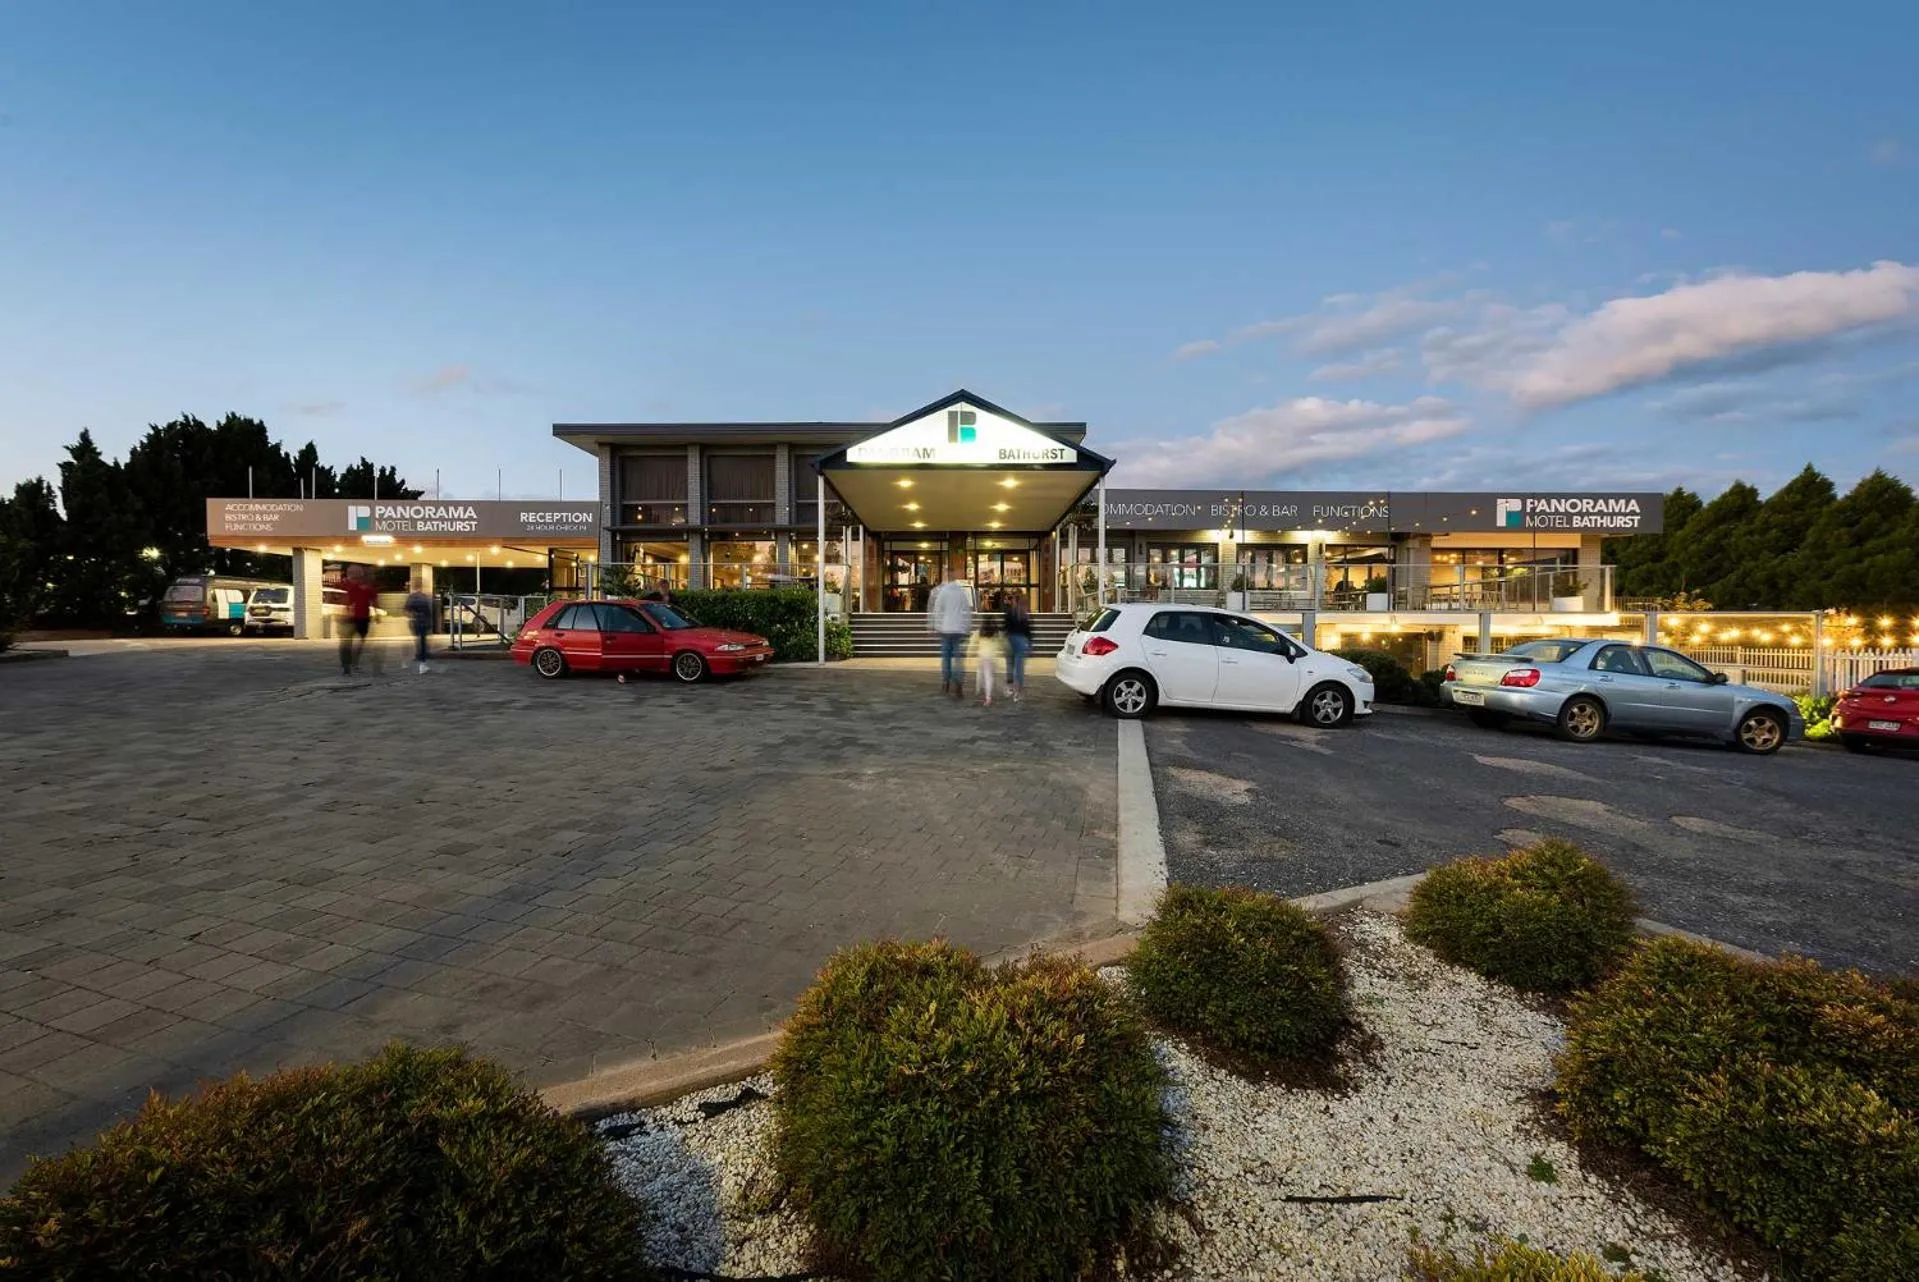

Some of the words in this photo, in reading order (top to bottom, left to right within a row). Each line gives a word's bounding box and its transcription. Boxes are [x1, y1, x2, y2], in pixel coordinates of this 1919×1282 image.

[998, 448, 1066, 460] BATHURST
[225, 503, 304, 512] ACCOMMODATION
[375, 505, 478, 518] PANORAMA
[1259, 505, 1268, 516] &
[1272, 505, 1298, 517] BAR
[1313, 505, 1389, 518] FUNCTIONS
[1525, 498, 1641, 513] PANORAMA
[225, 513, 254, 521] BISTRO
[263, 514, 280, 522] BAR
[520, 511, 593, 523] RECEPTION
[1525, 515, 1570, 528] MOTEL
[1572, 515, 1641, 528] BATHURST
[225, 522, 273, 532] FUNCTIONS
[375, 520, 415, 531] MOTEL
[416, 521, 478, 531] BATHURST
